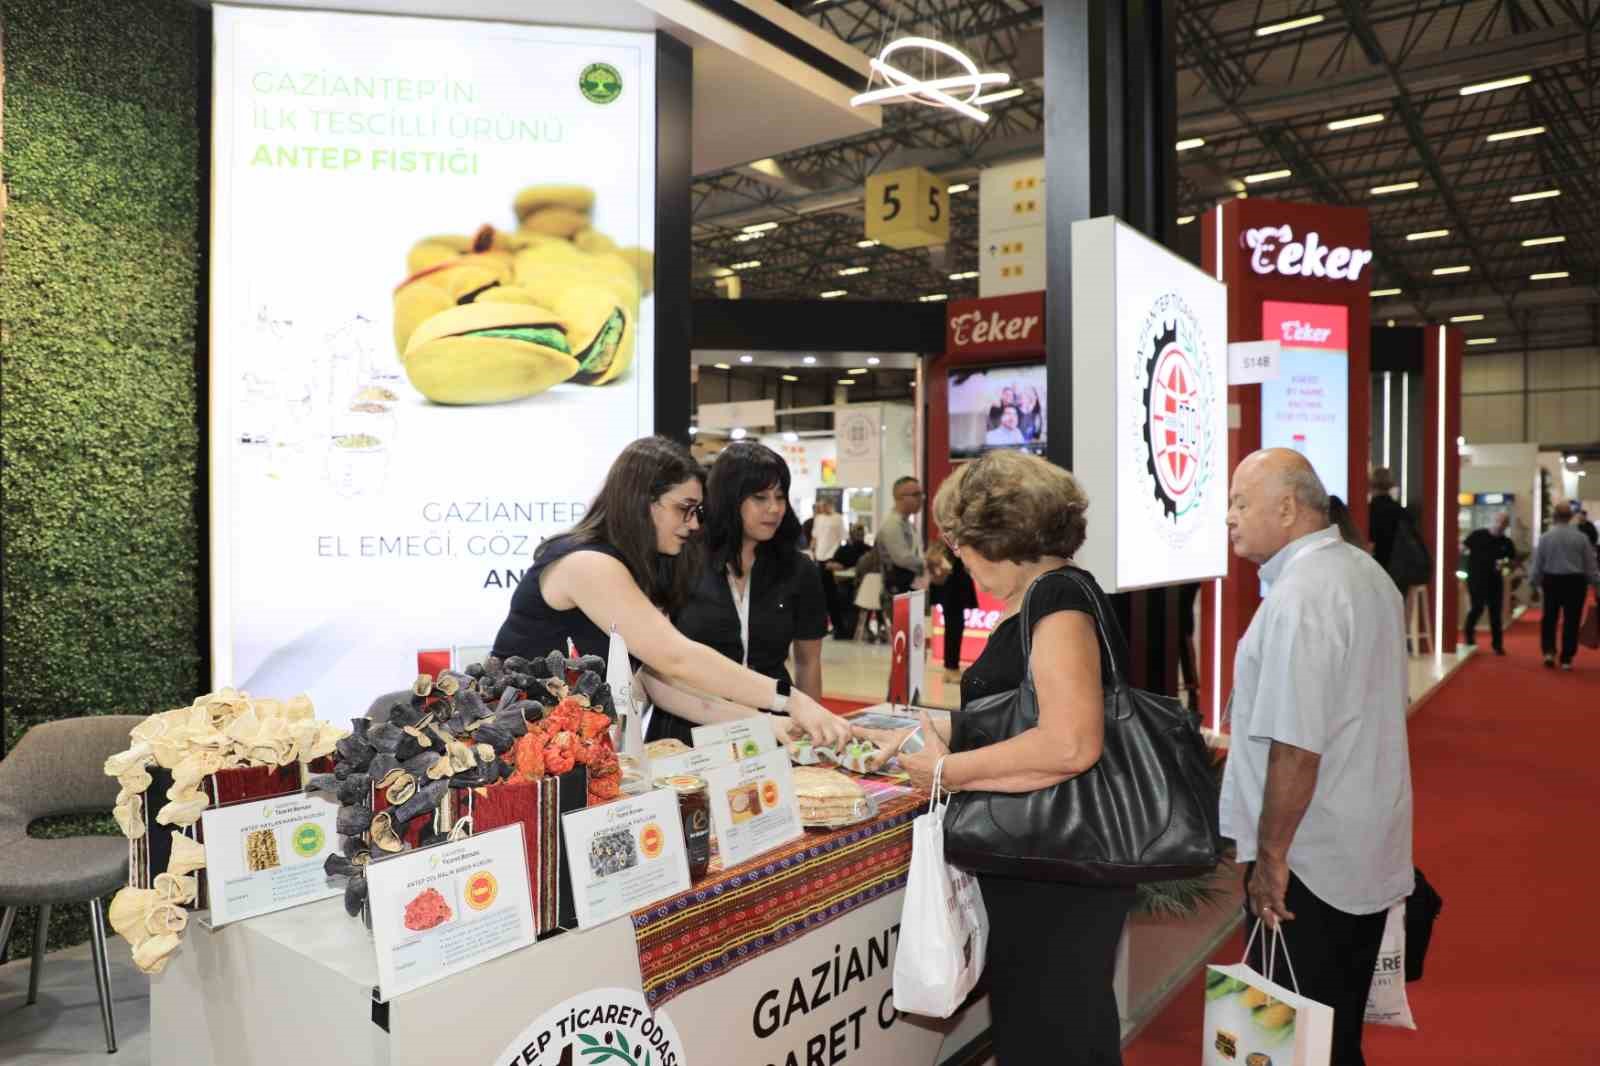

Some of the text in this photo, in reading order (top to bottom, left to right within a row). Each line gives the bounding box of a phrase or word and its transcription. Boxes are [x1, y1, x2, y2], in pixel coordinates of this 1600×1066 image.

[251, 99, 565, 143] İLK TESCİLLİ ÜRÜNÜ
[250, 143, 478, 175] ANTEP FISTIĞI
[881, 184, 901, 222] 5
[928, 186, 941, 222] 5
[317, 535, 349, 557] EL
[466, 530, 529, 557] GÖZ
[484, 569, 524, 588] AN
[555, 1003, 643, 1038] TİCARET
[640, 1017, 679, 1066] ODAS
